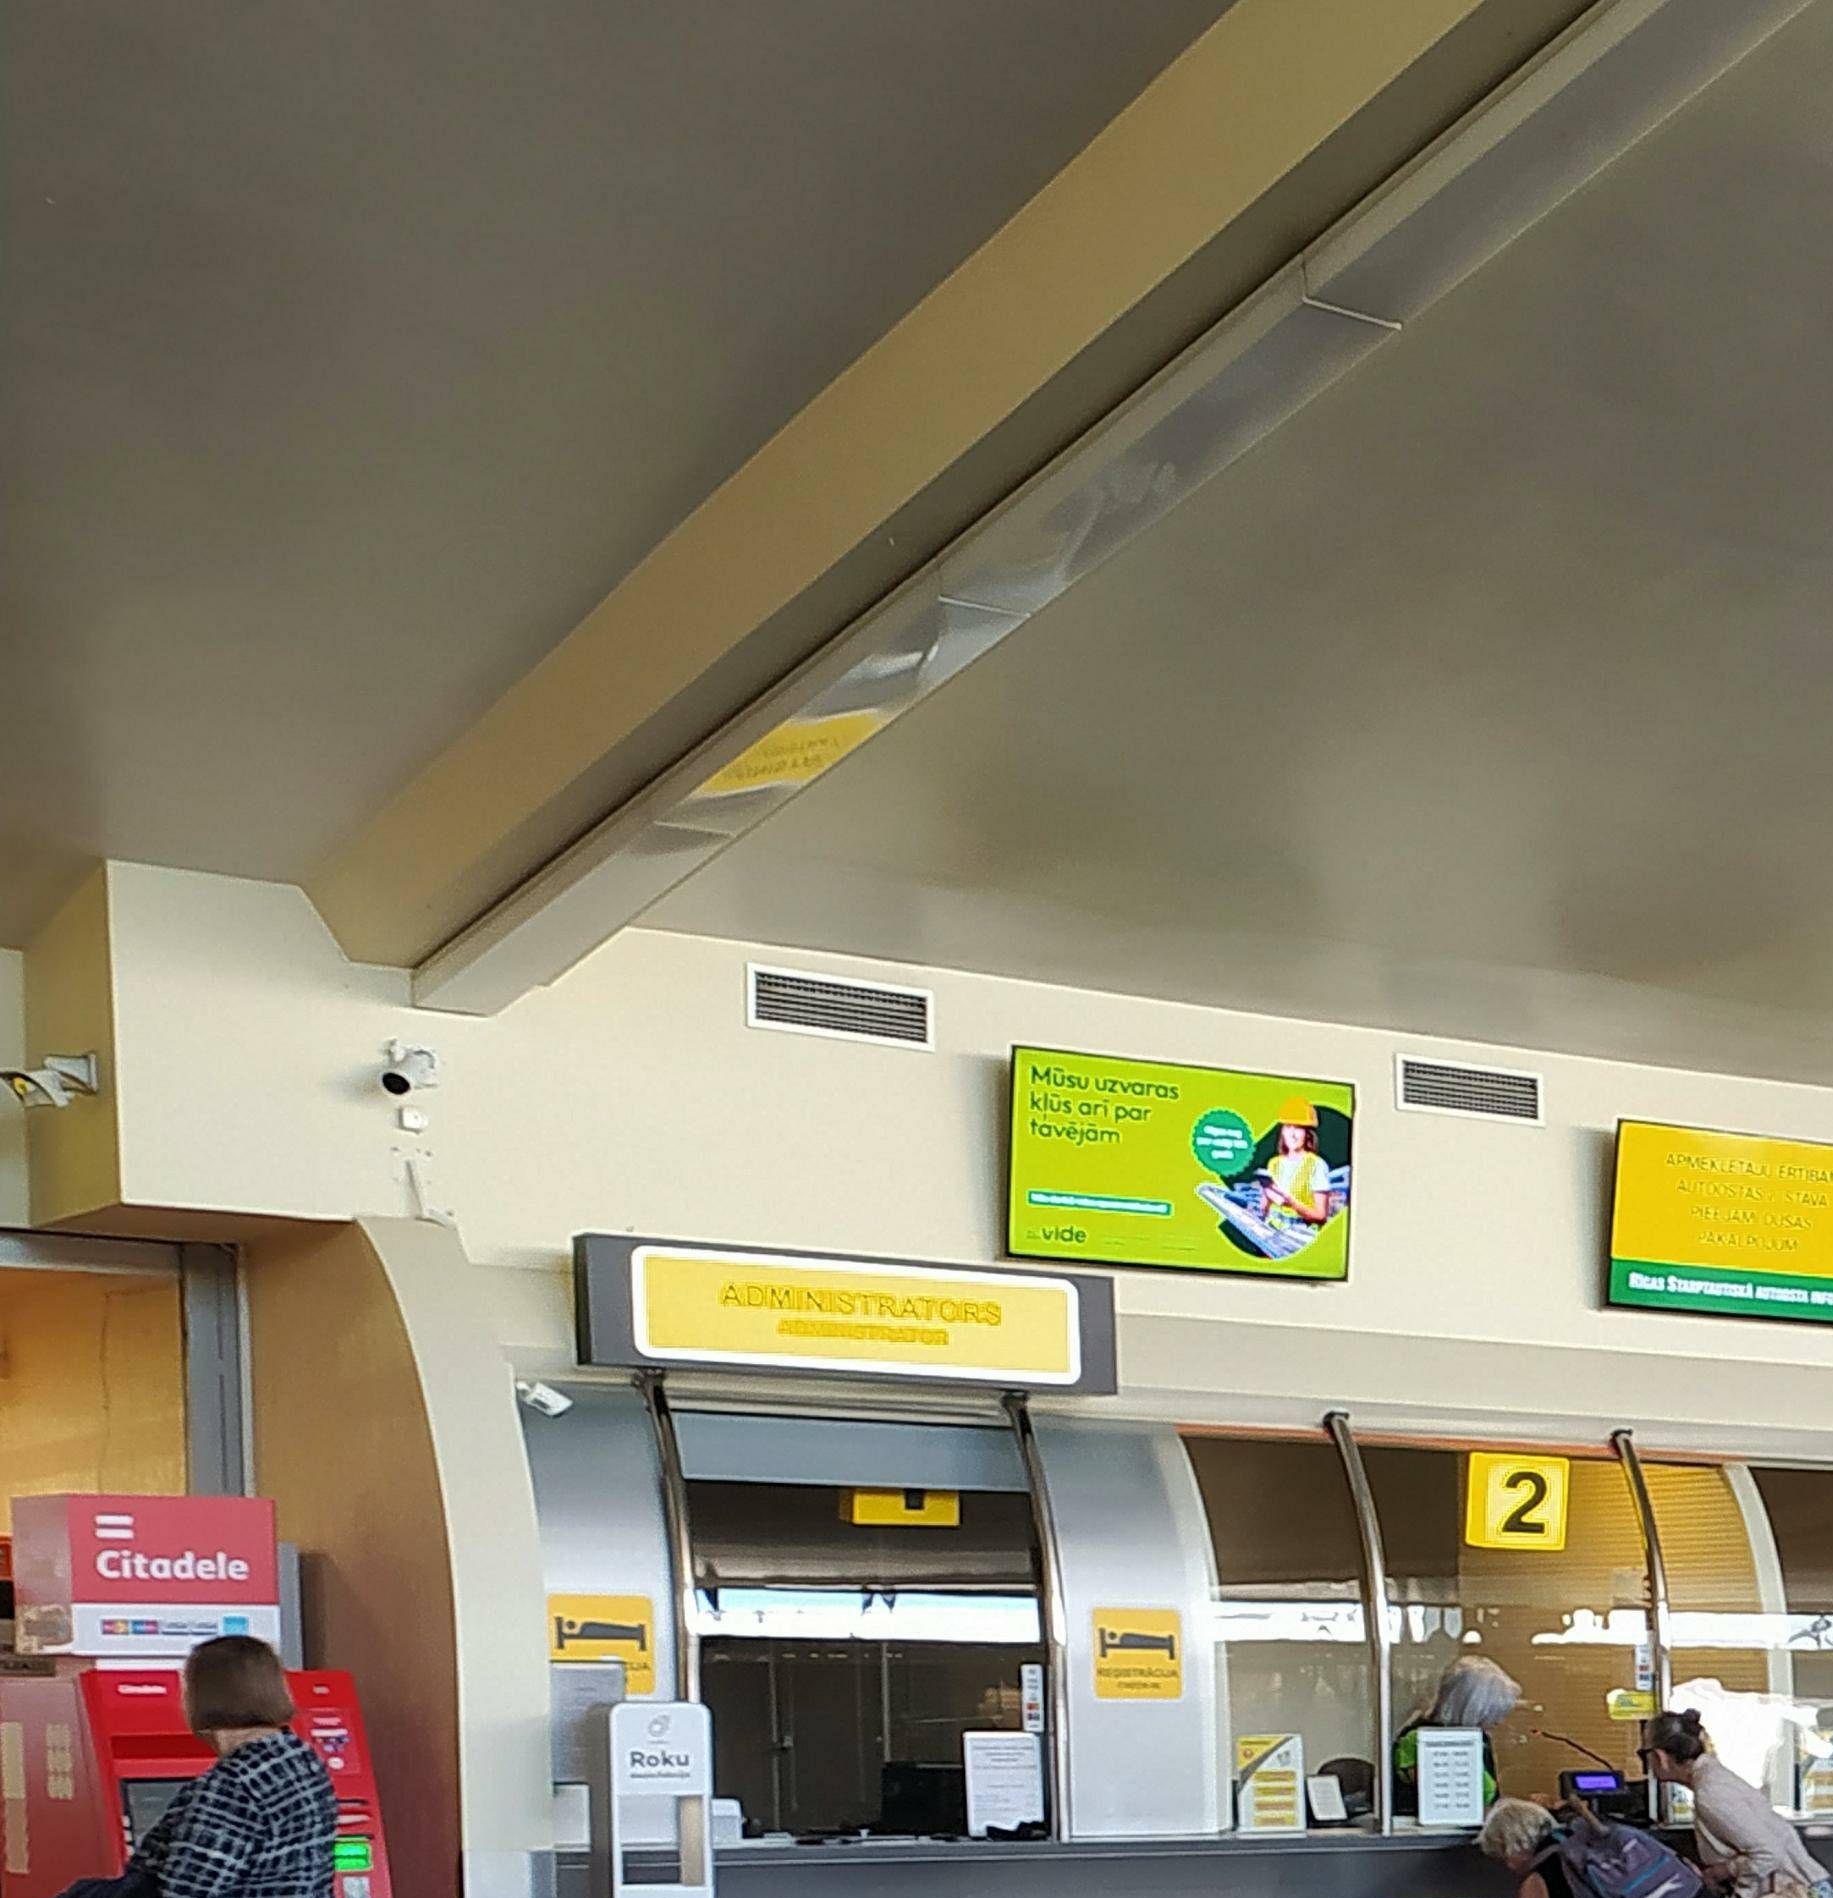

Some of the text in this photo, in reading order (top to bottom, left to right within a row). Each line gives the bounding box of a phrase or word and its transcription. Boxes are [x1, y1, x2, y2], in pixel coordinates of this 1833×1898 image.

[1030, 1065, 1180, 1100] Mūsu uzvaras
[1114, 1105, 1152, 1124] par
[1041, 1225, 1087, 1244] vide
[721, 1281, 1002, 1327] ADMINISTRATORS
[1500, 1470, 1548, 1535] 2
[95, 1549, 250, 1581] Citadele
[630, 1749, 690, 1768] Roku
